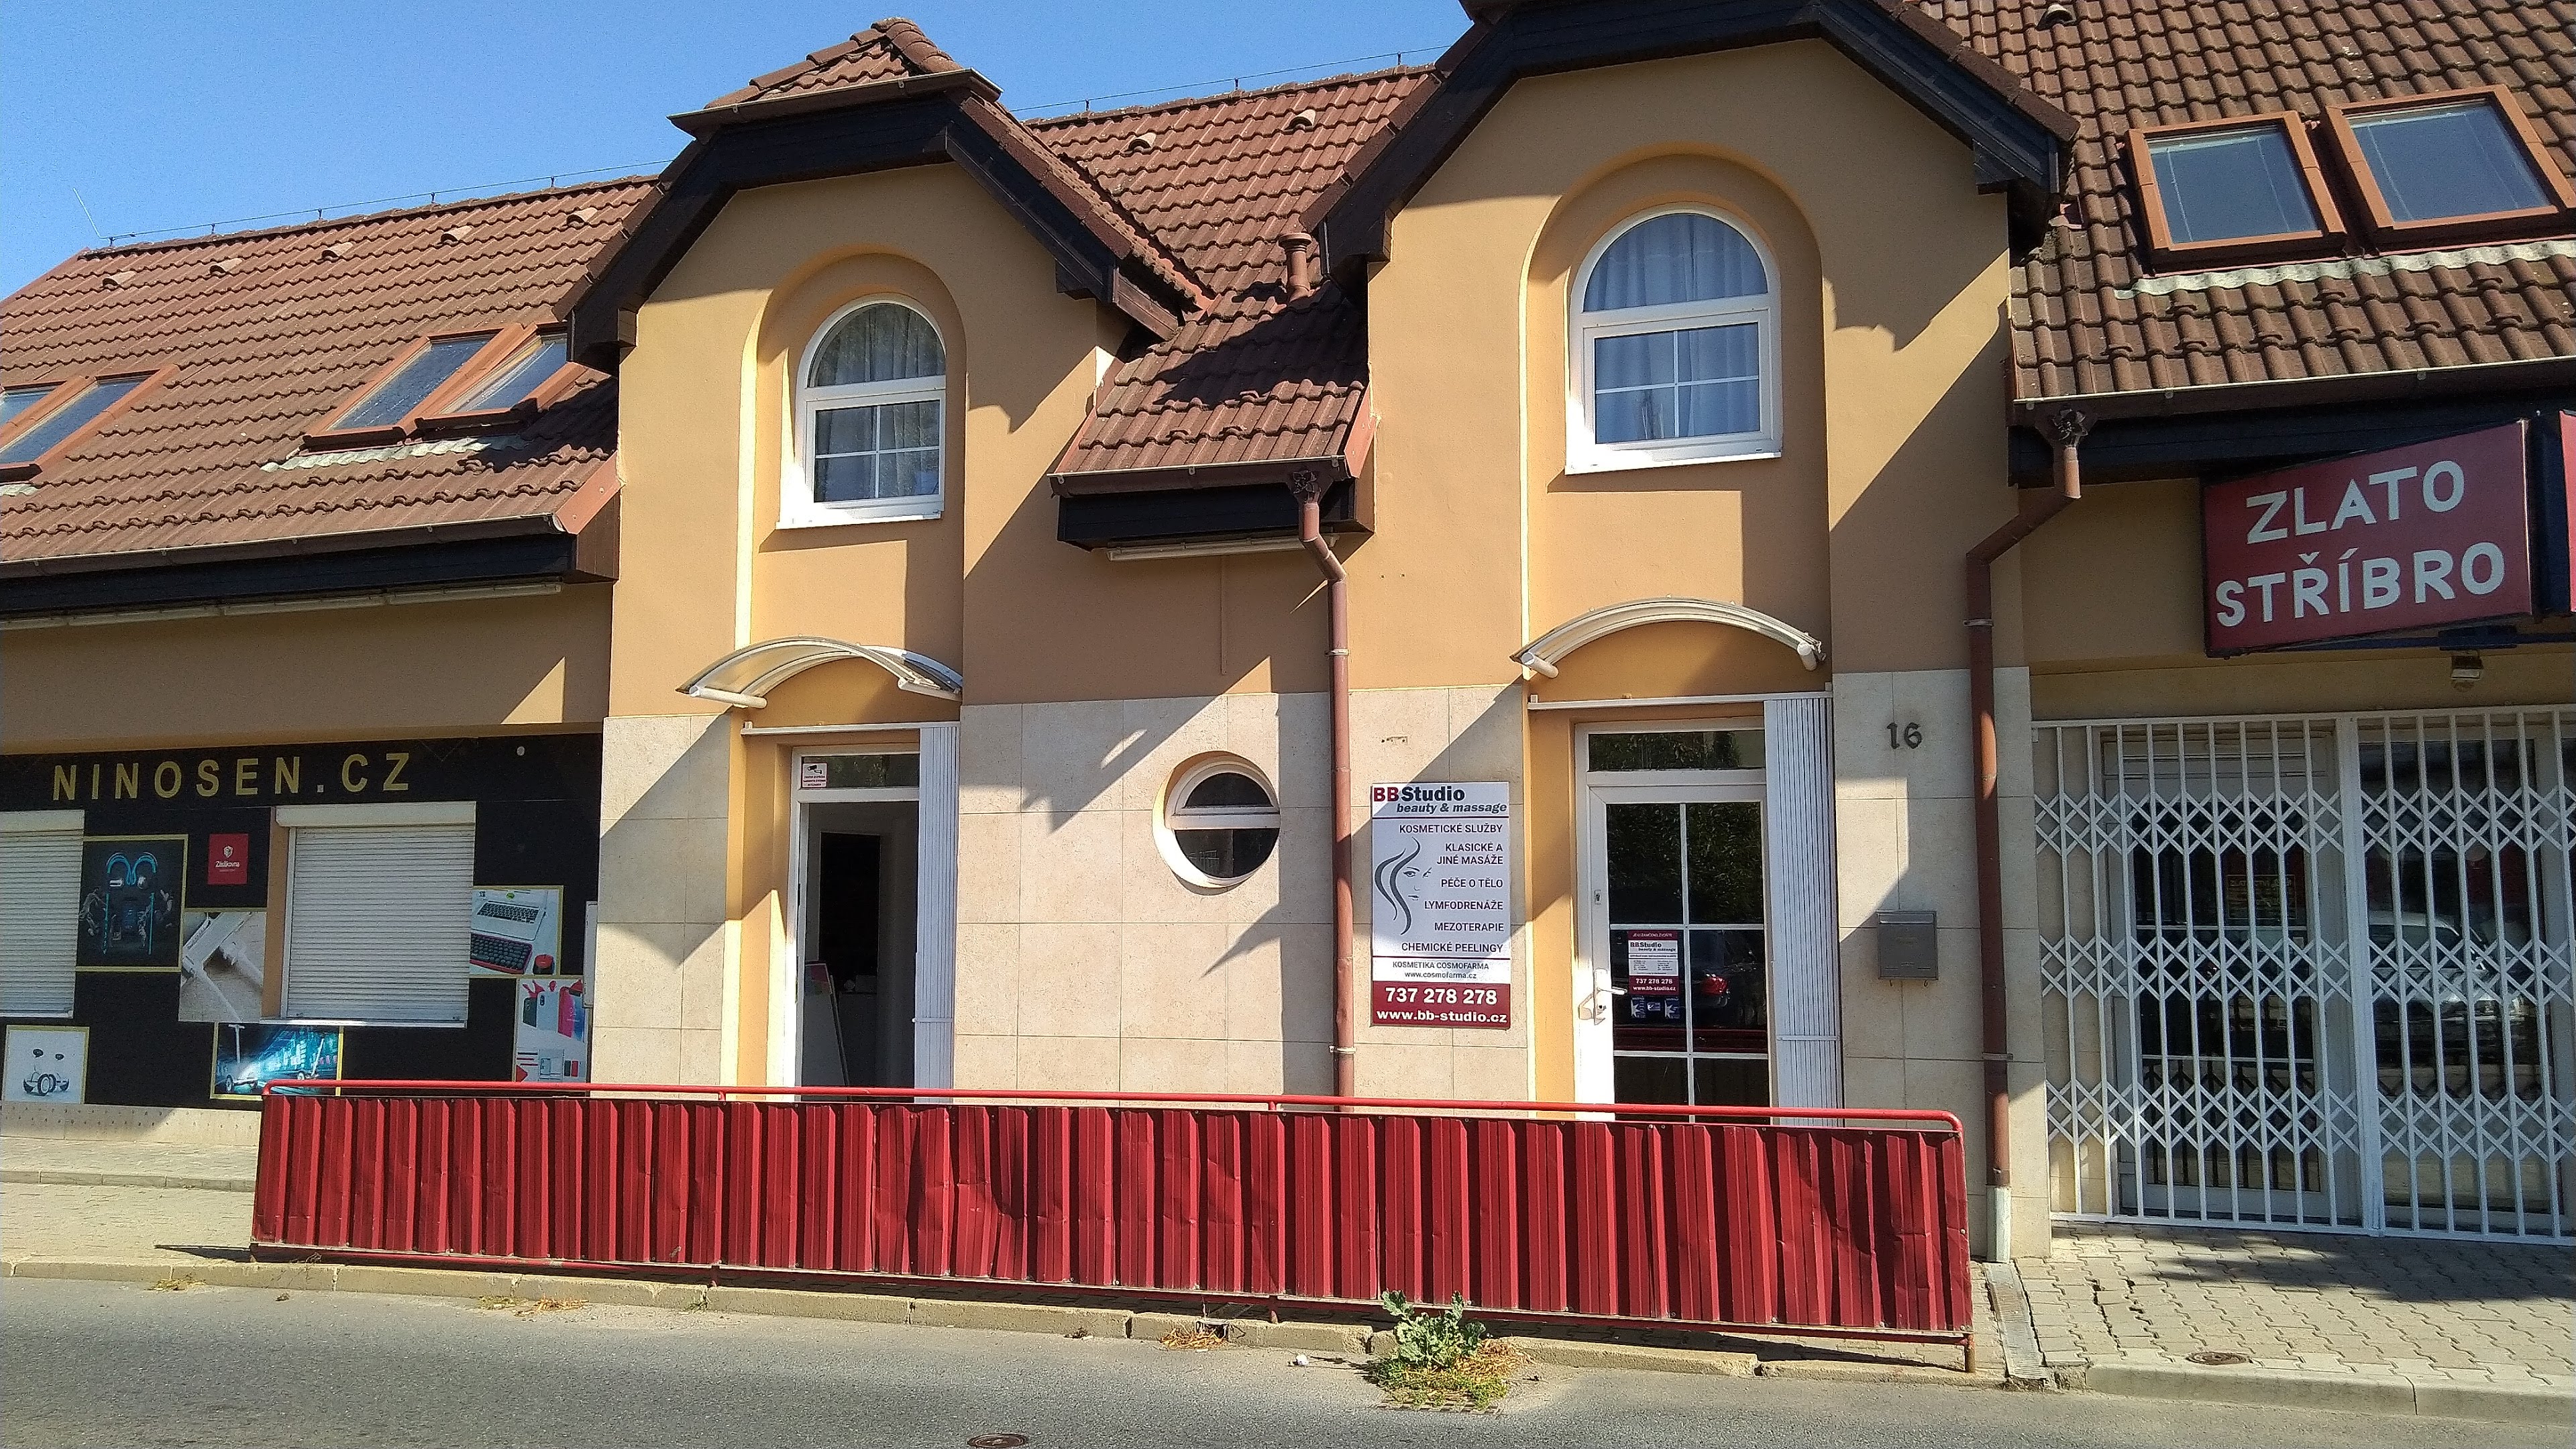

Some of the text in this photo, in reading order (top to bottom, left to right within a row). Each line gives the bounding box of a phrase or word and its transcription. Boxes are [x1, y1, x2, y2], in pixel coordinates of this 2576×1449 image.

[2246, 460, 2465, 545] ZLATO
[2216, 541, 2505, 627] STŘÍBRO
[1886, 722, 1923, 749] 16
[53, 753, 410, 801] NINOSEN.CZ
[1373, 786, 1465, 802] BBStudio
[1396, 803, 1507, 814] beauty & massage
[1399, 822, 1503, 833] KOSMETICKÉ SLUŽBY
[1446, 841, 1503, 852] KLASICKÉ A
[1436, 854, 1503, 865] JINÉ MASÁŽE
[1441, 877, 1503, 888] PÉČE O TĚLO
[1424, 900, 1503, 910] LYMFODRENÁŽE
[1434, 922, 1504, 932] MEZOTERAPIE
[1401, 941, 1503, 953] CHEMICKÉ PEELINGY
[1405, 971, 1477, 979] www.cosmofarma.cz
[1385, 987, 1497, 1005] 737 278 278
[1377, 1010, 1507, 1023] www.bb-studio.cz
